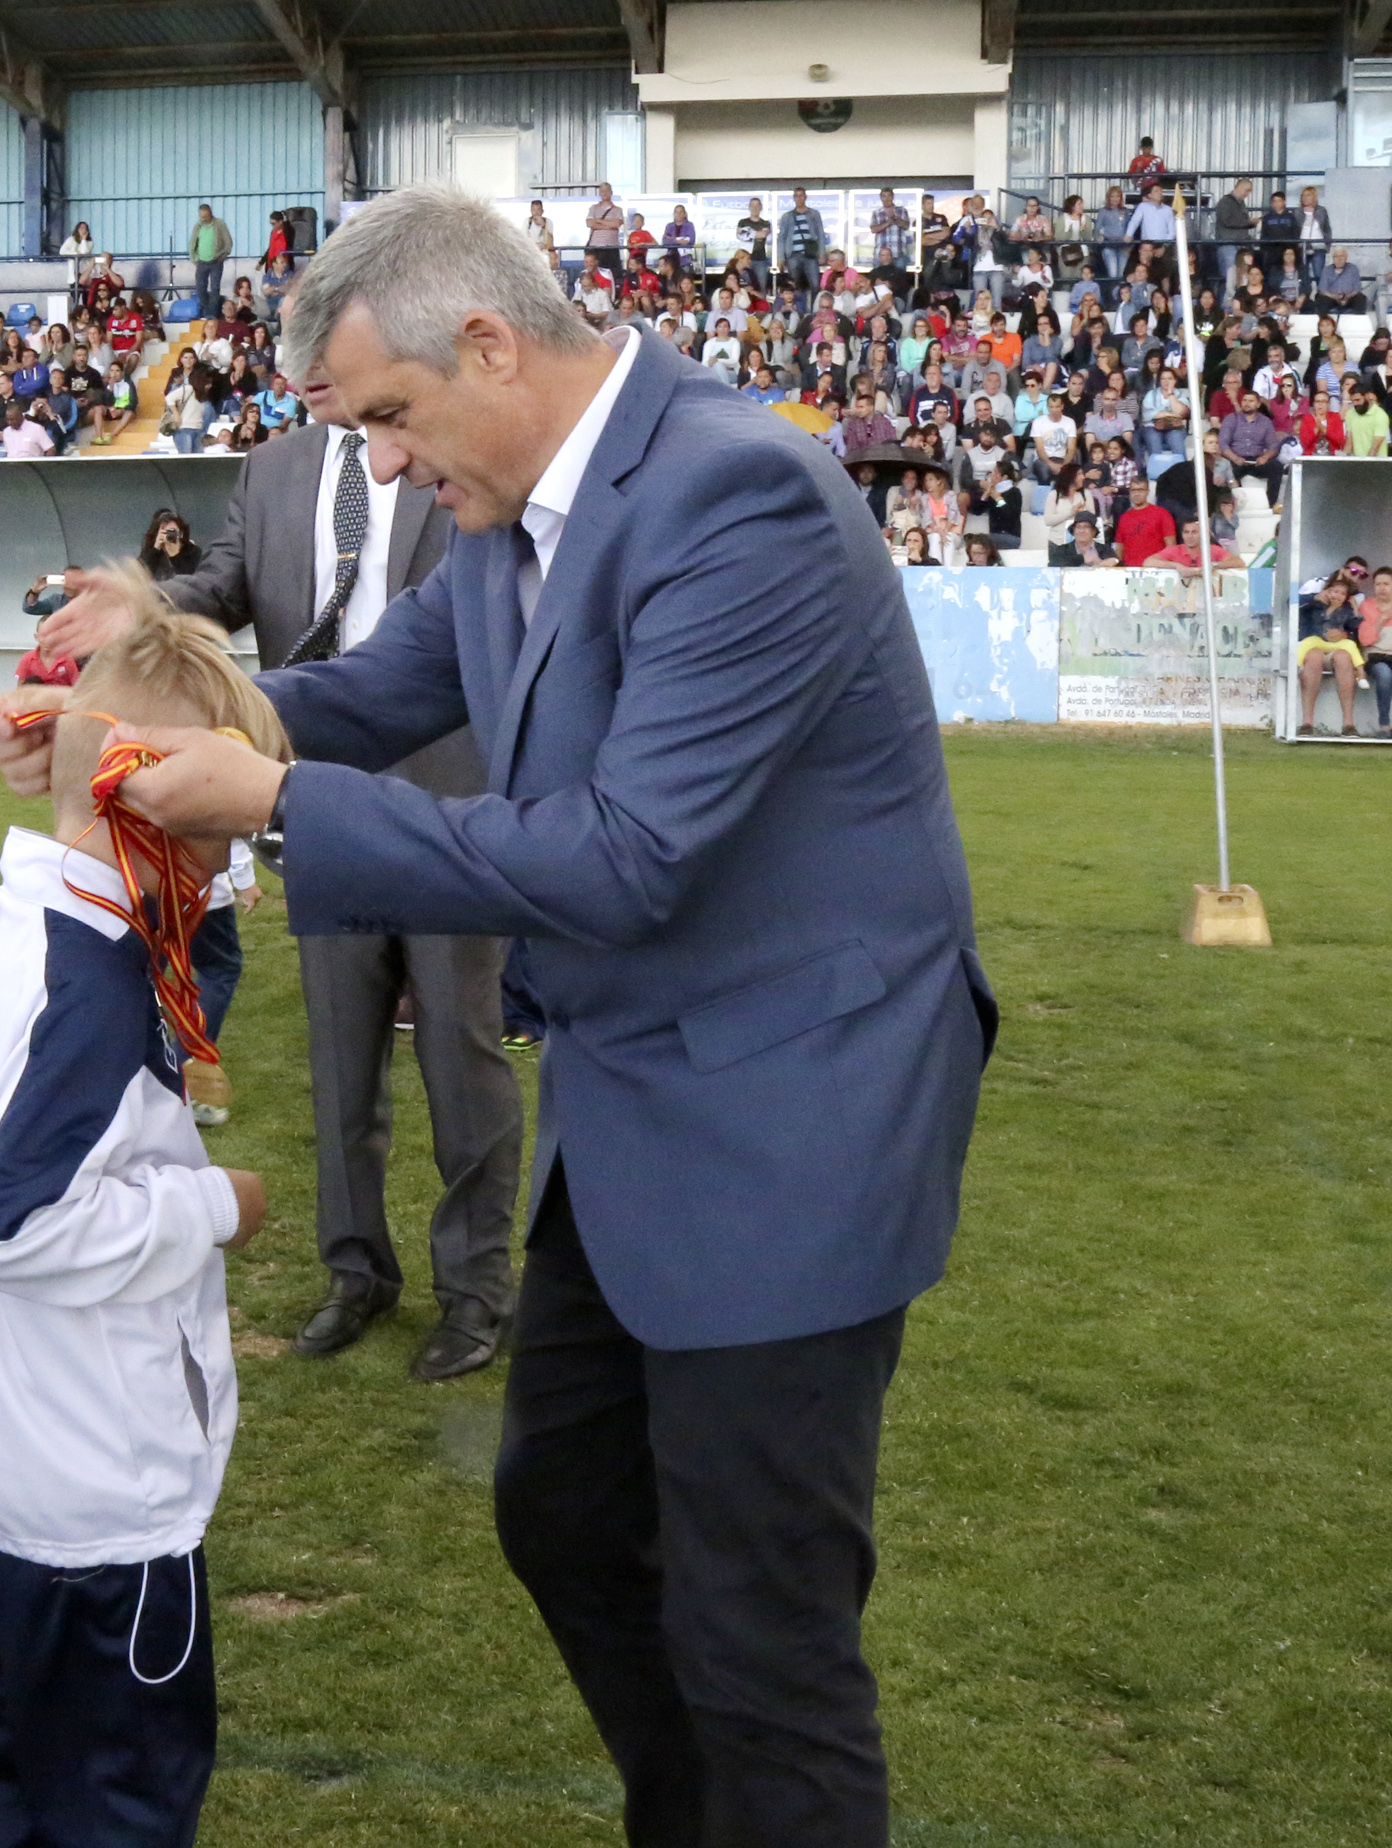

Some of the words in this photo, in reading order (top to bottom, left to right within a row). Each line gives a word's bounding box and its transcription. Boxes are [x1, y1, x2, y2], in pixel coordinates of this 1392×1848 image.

[1092, 684, 1103, 693] de
[1092, 697, 1103, 705] de
[1084, 708, 1094, 717] 91
[1096, 708, 1111, 718] 647
[1113, 709, 1124, 718] 60
[1126, 709, 1136, 718] 46
